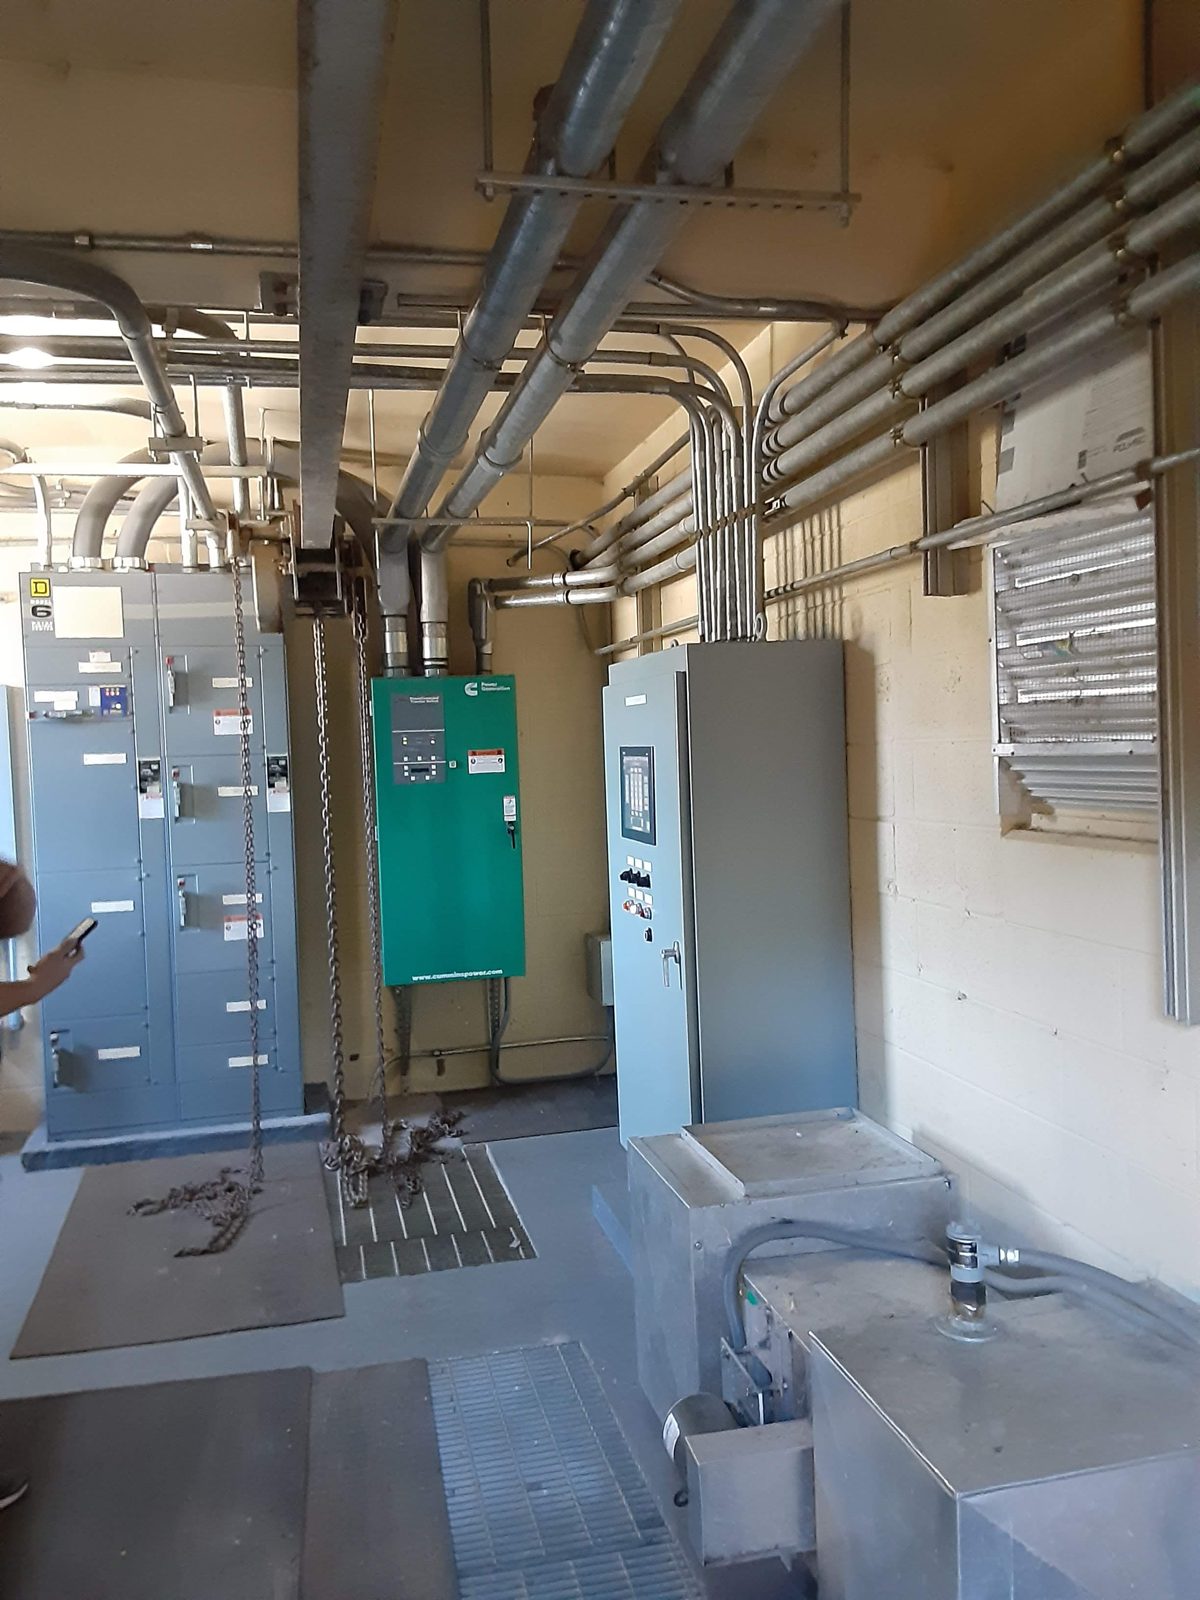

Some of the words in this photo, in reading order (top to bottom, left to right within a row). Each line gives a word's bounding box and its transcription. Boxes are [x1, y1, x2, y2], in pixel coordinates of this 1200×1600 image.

[32, 580, 48, 595] D
[31, 604, 52, 618] 6
[412, 968, 503, 981] www.cumminspower.com
